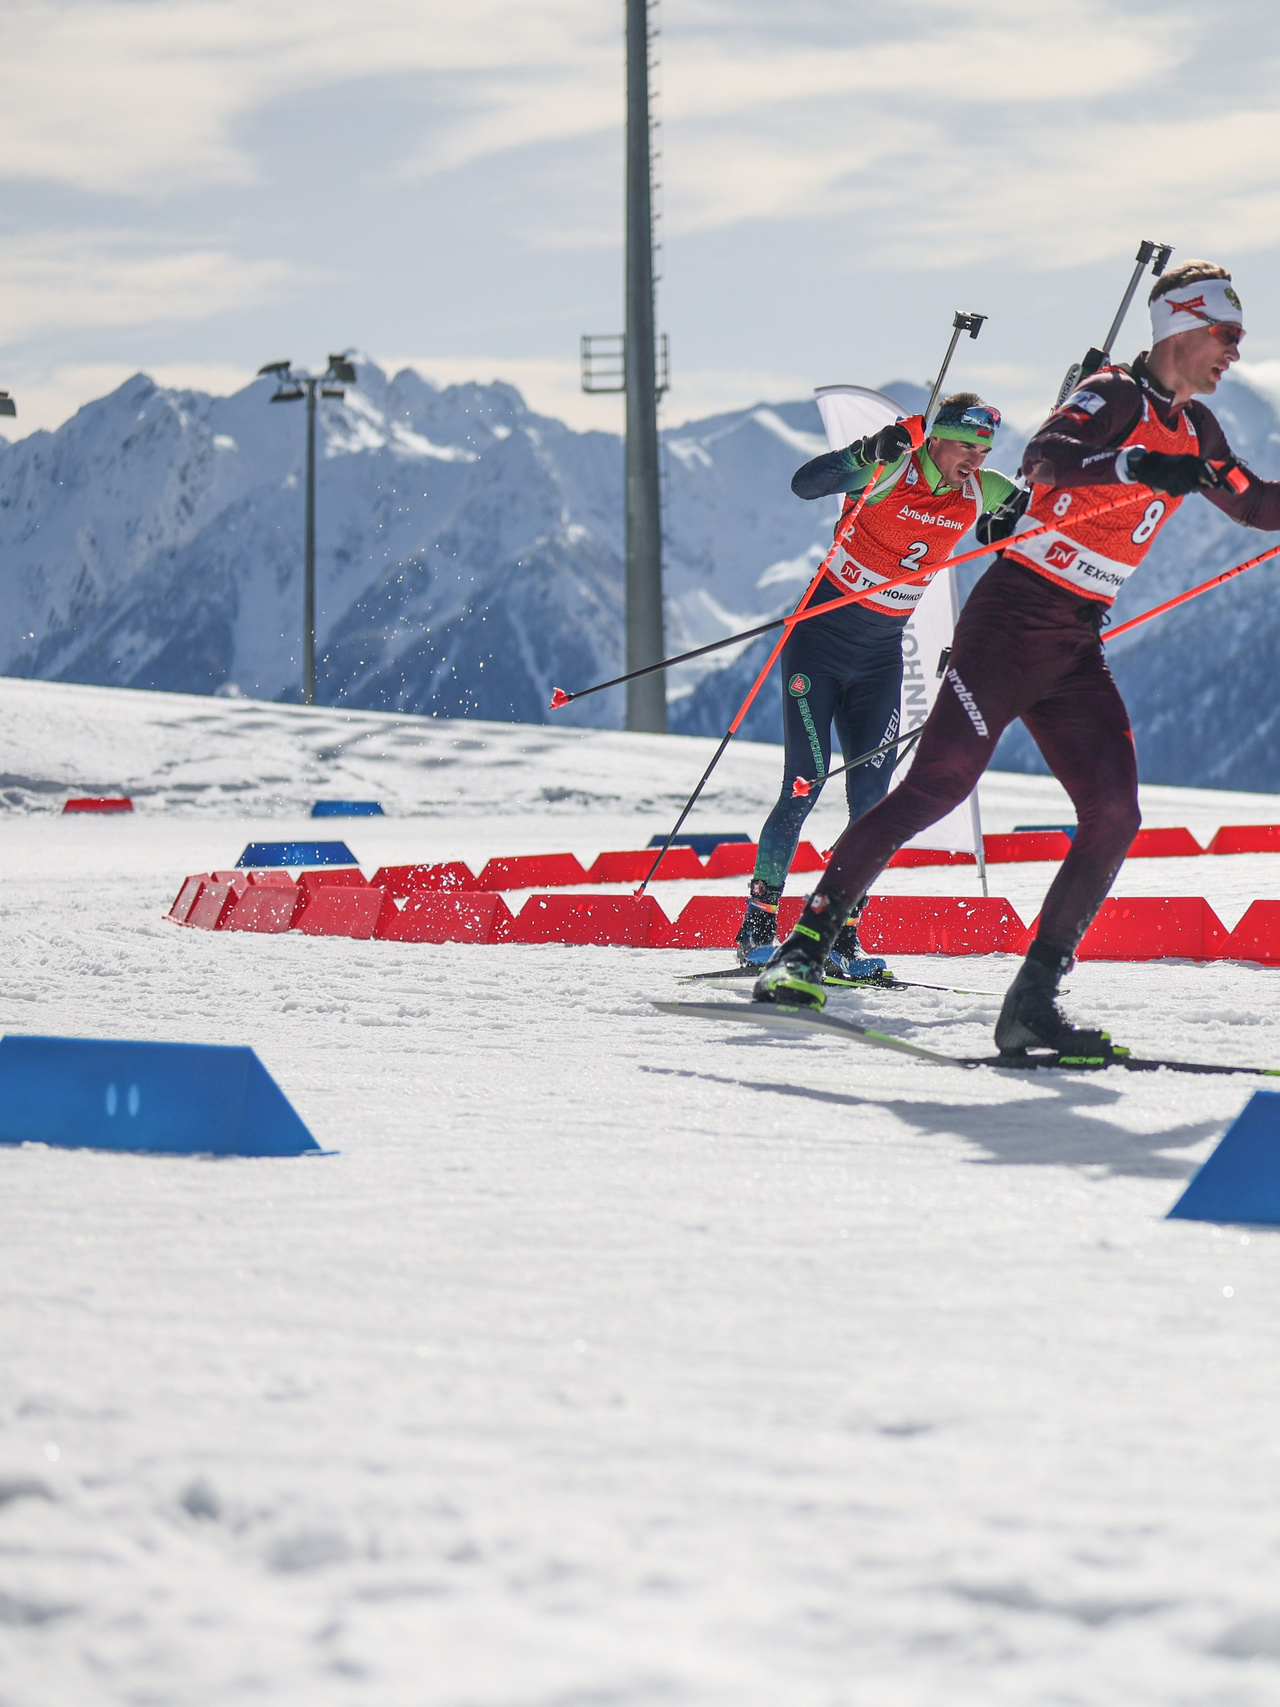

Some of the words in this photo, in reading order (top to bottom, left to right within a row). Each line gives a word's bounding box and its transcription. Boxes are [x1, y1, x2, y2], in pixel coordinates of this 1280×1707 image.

[1059, 372, 1077, 405] ARSEN
[897, 505, 936, 525] Альфа
[936, 515, 965, 531] Банк
[1053, 493, 1072, 516] 8
[1131, 499, 1166, 545] 8
[899, 540, 930, 571] 2
[1059, 1056, 1105, 1065] FISCHER
